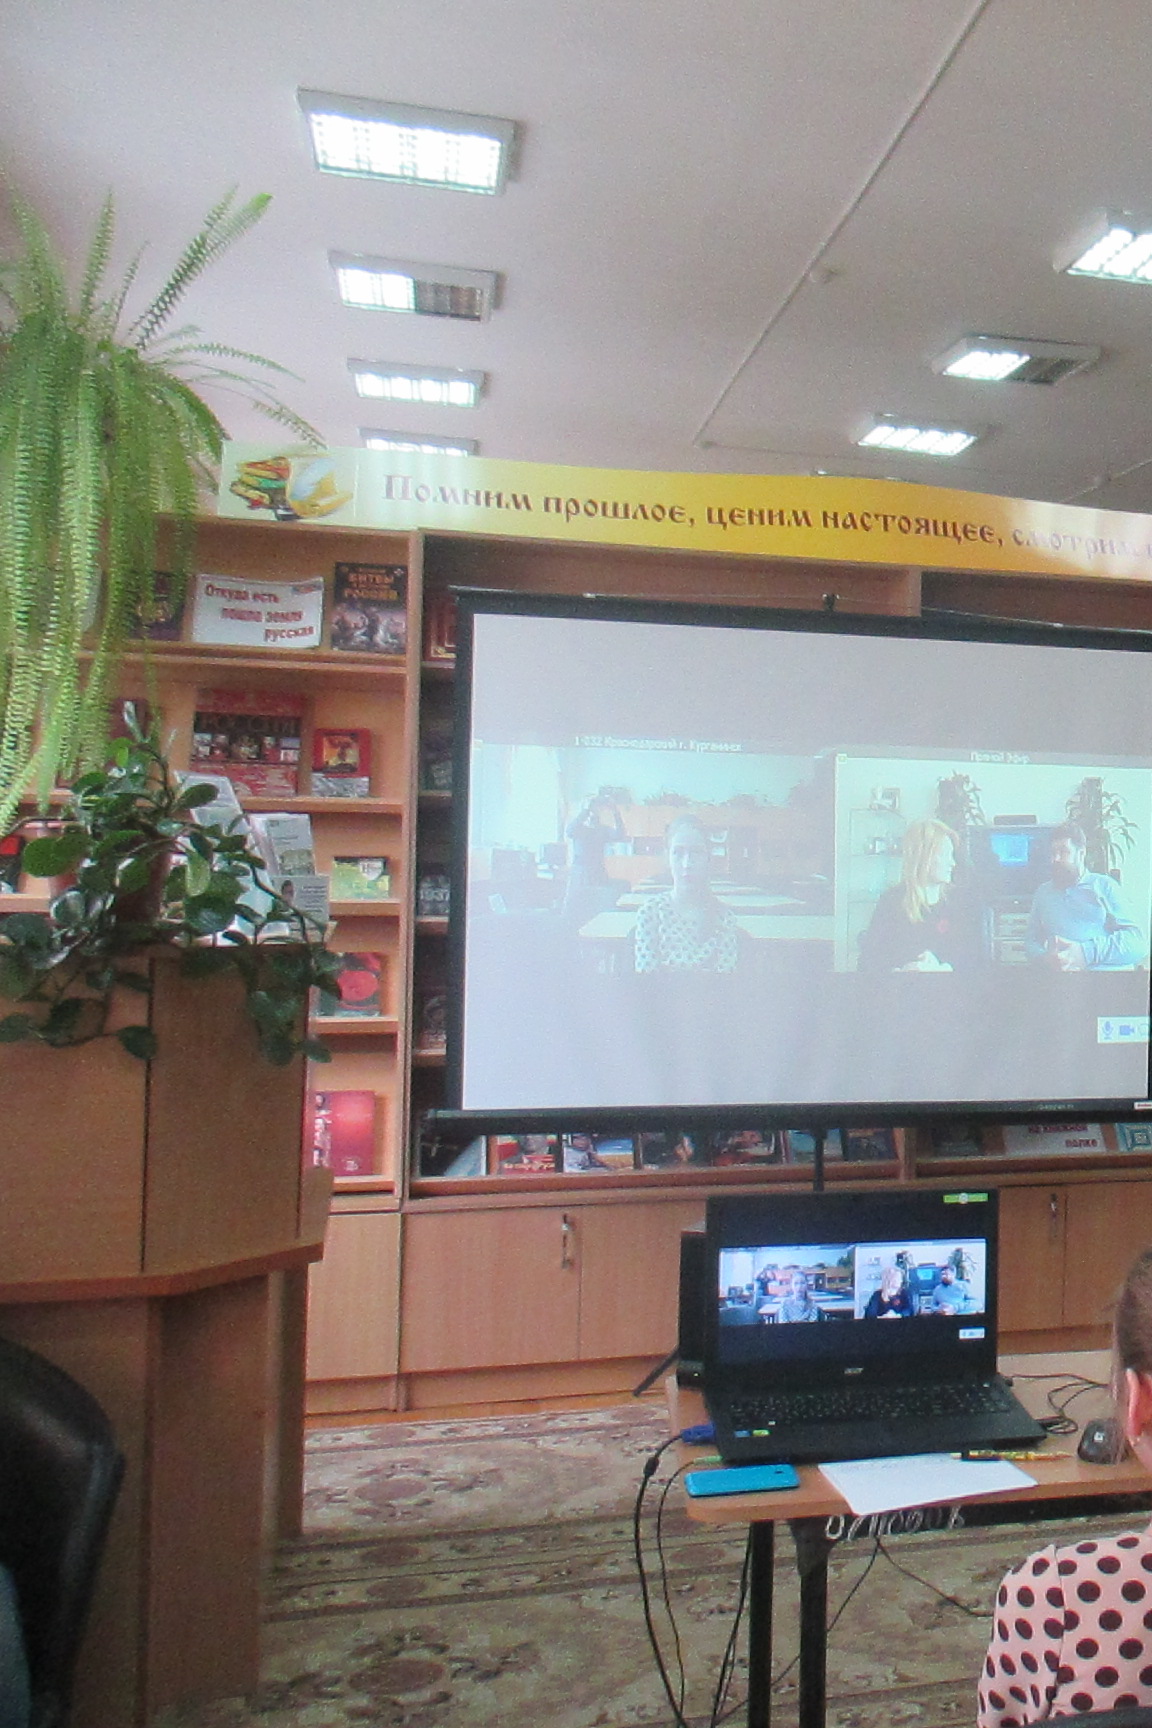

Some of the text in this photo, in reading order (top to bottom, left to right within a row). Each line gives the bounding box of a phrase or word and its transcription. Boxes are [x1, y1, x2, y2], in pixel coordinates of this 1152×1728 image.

[383, 474, 532, 512] Помним
[542, 495, 696, 527] прошлое,
[706, 506, 812, 531] ценим
[821, 509, 1003, 547] настоящее,
[205, 583, 281, 604] Откуда есть
[264, 625, 315, 643] русская
